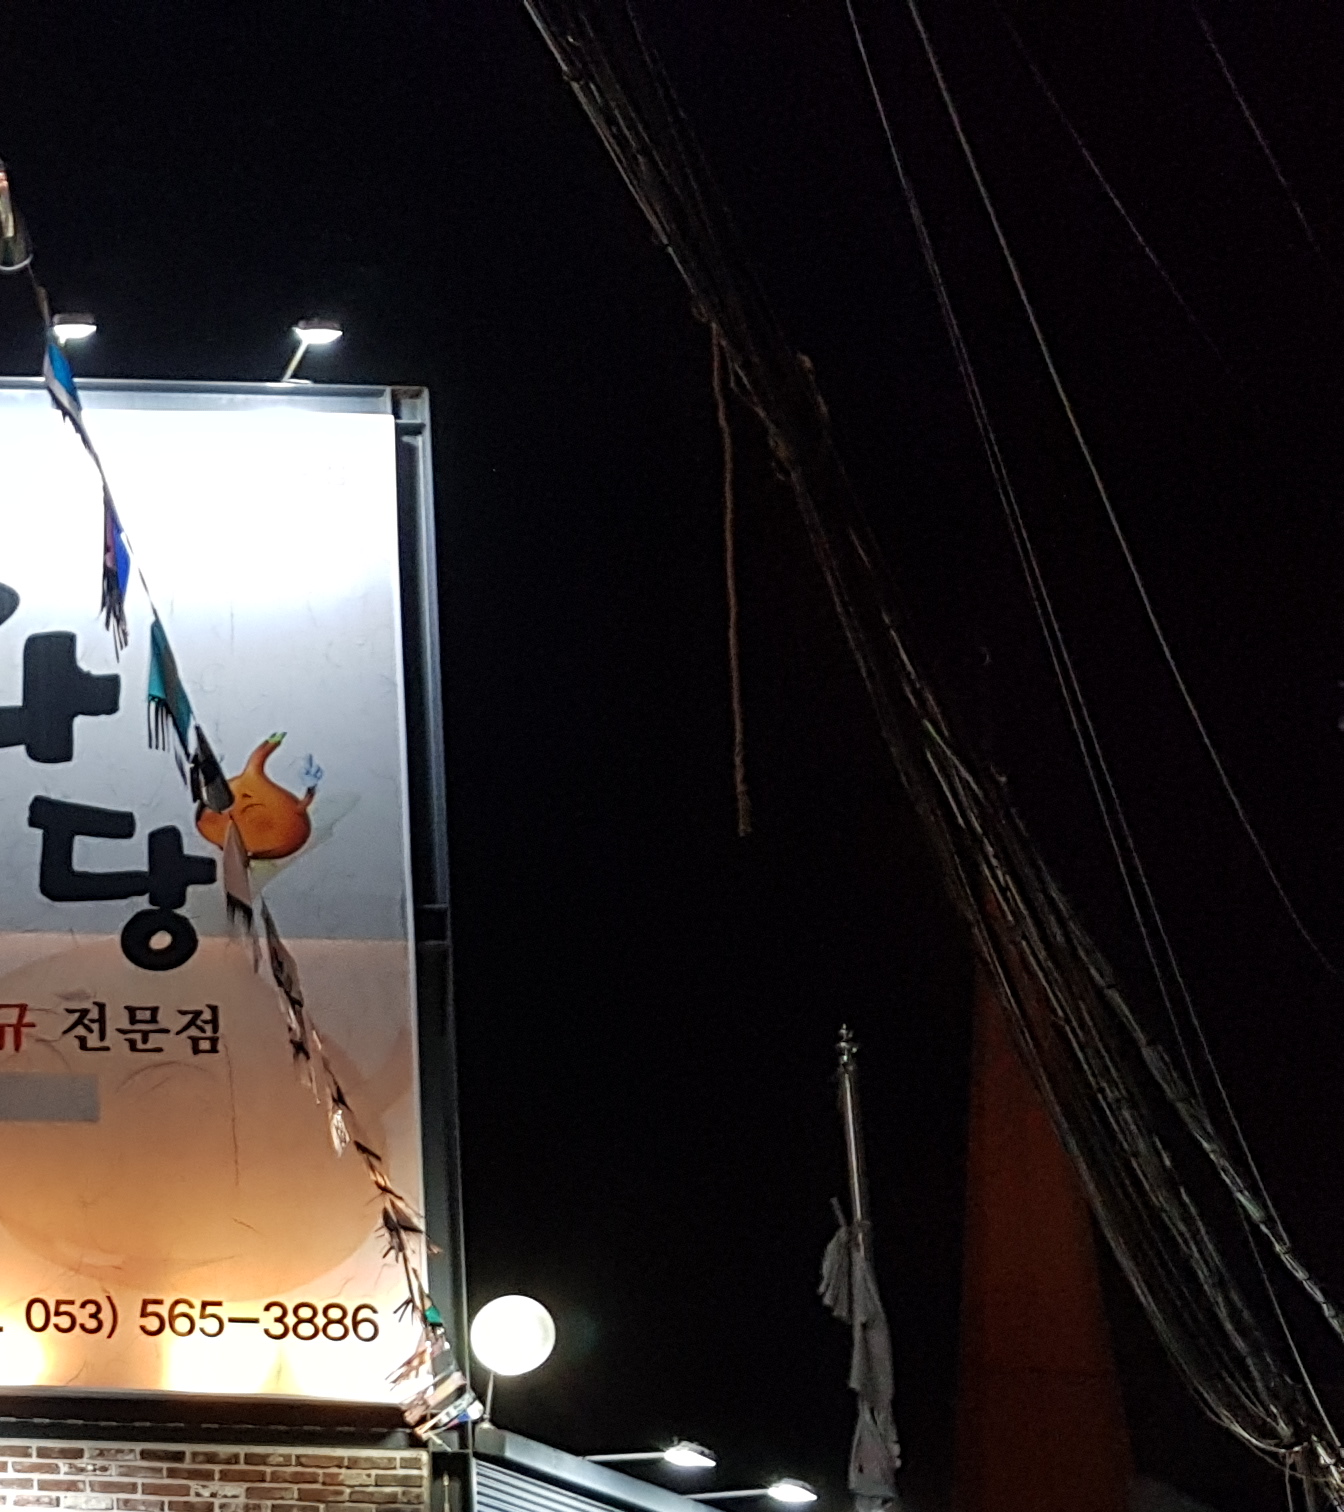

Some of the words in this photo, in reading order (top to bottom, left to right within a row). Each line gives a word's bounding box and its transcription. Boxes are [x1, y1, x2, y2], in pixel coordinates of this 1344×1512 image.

[61, 1001, 221, 1054] 전문점
[24, 1294, 120, 1339] 053)
[138, 1297, 380, 1343] 565-3886
